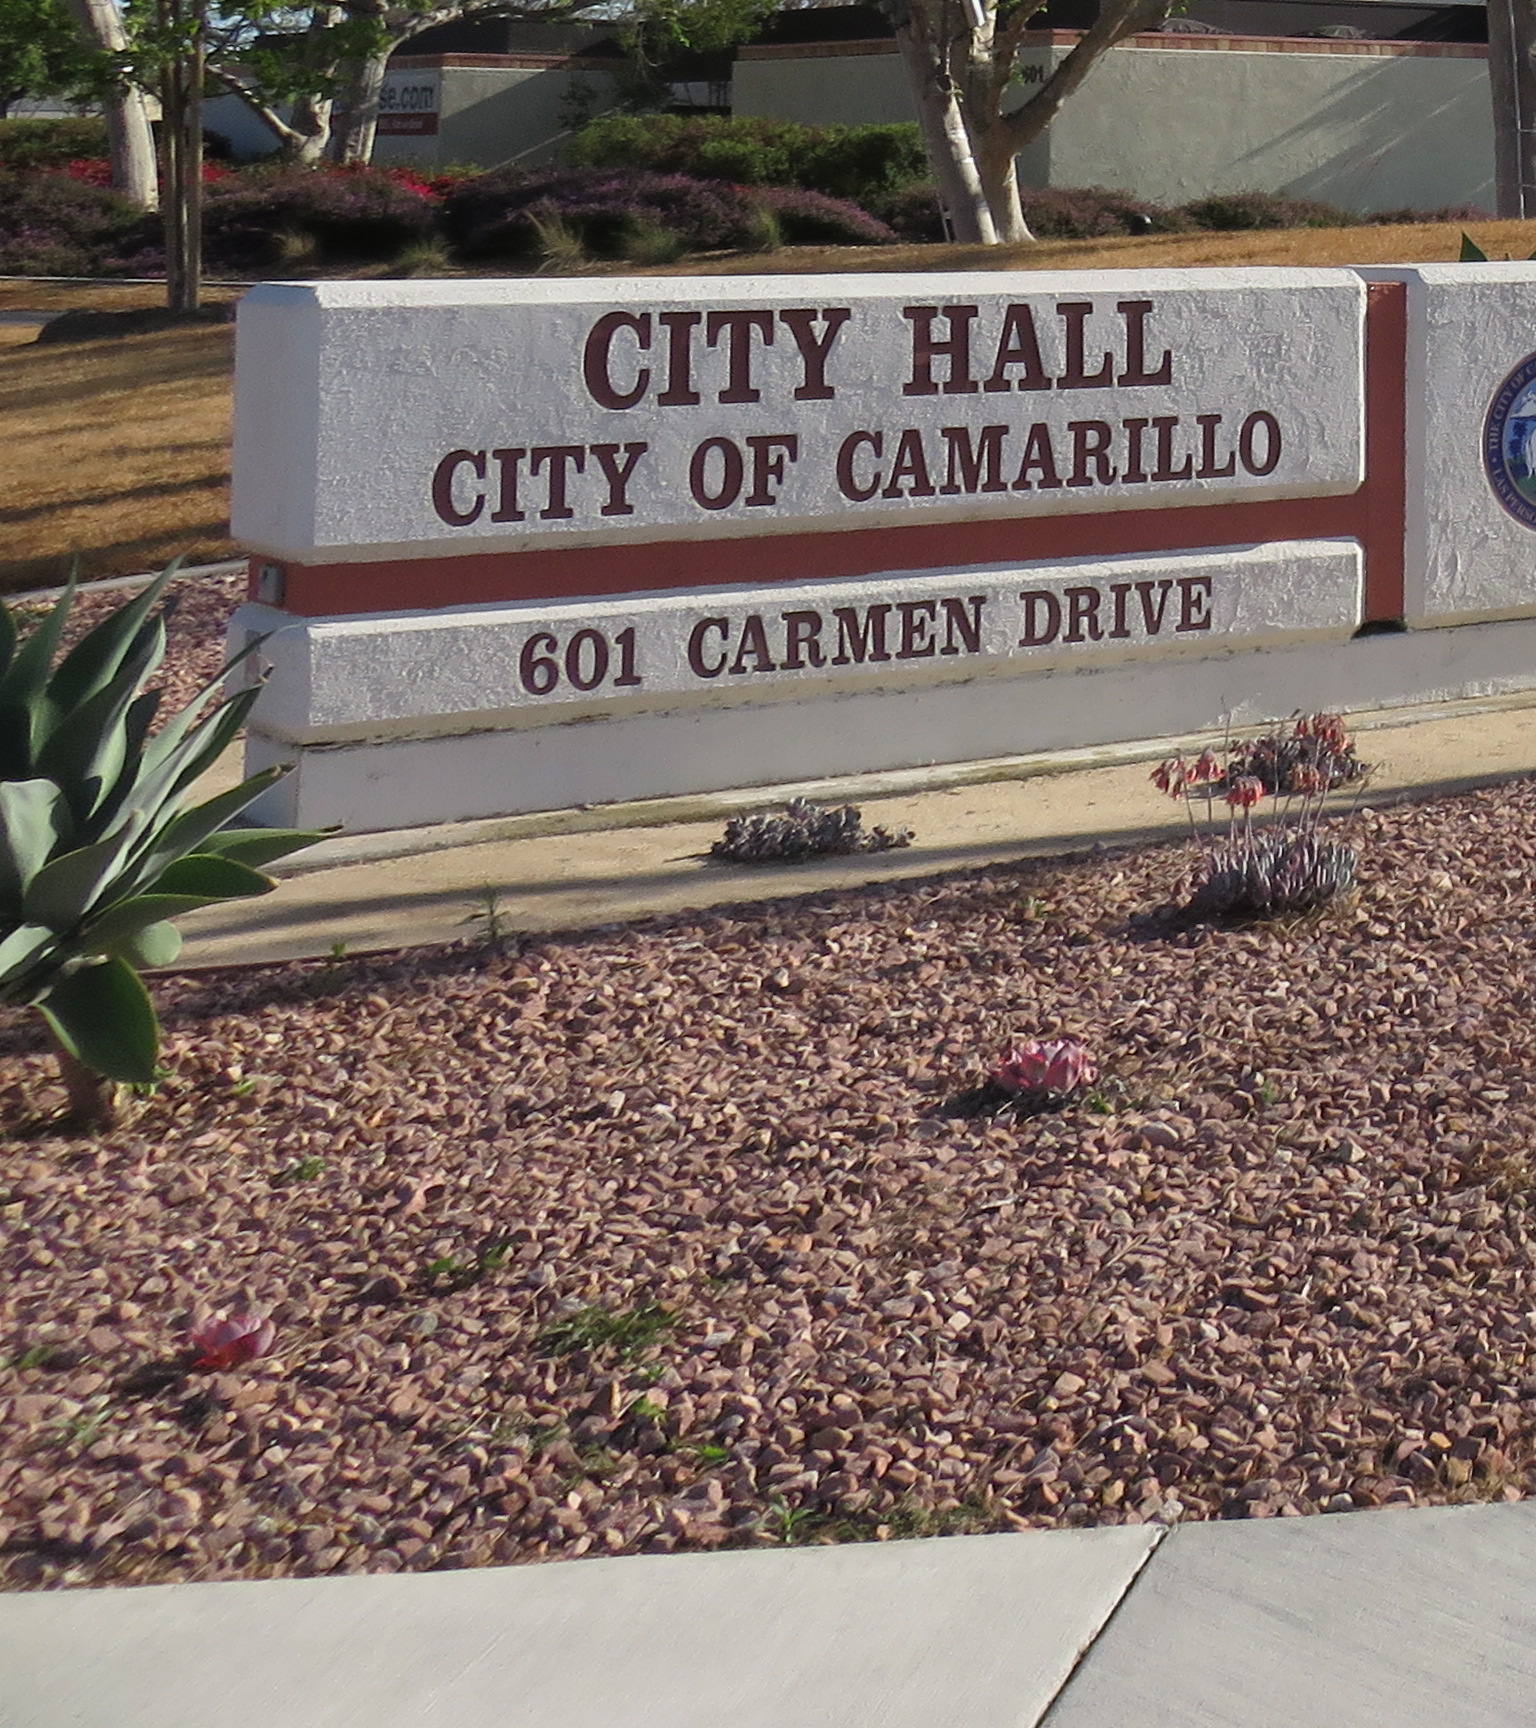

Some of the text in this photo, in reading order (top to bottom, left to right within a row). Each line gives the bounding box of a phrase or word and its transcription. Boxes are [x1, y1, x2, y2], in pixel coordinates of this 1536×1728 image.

[583, 299, 1173, 411] CITY HALL
[1510, 372, 1526, 389] OF
[1488, 425, 1500, 450] THE
[1493, 387, 1514, 420] CITY
[431, 409, 1282, 528] CITY OF CAMARILLO
[519, 575, 1213, 696] 601 CARMEN DRIVE
